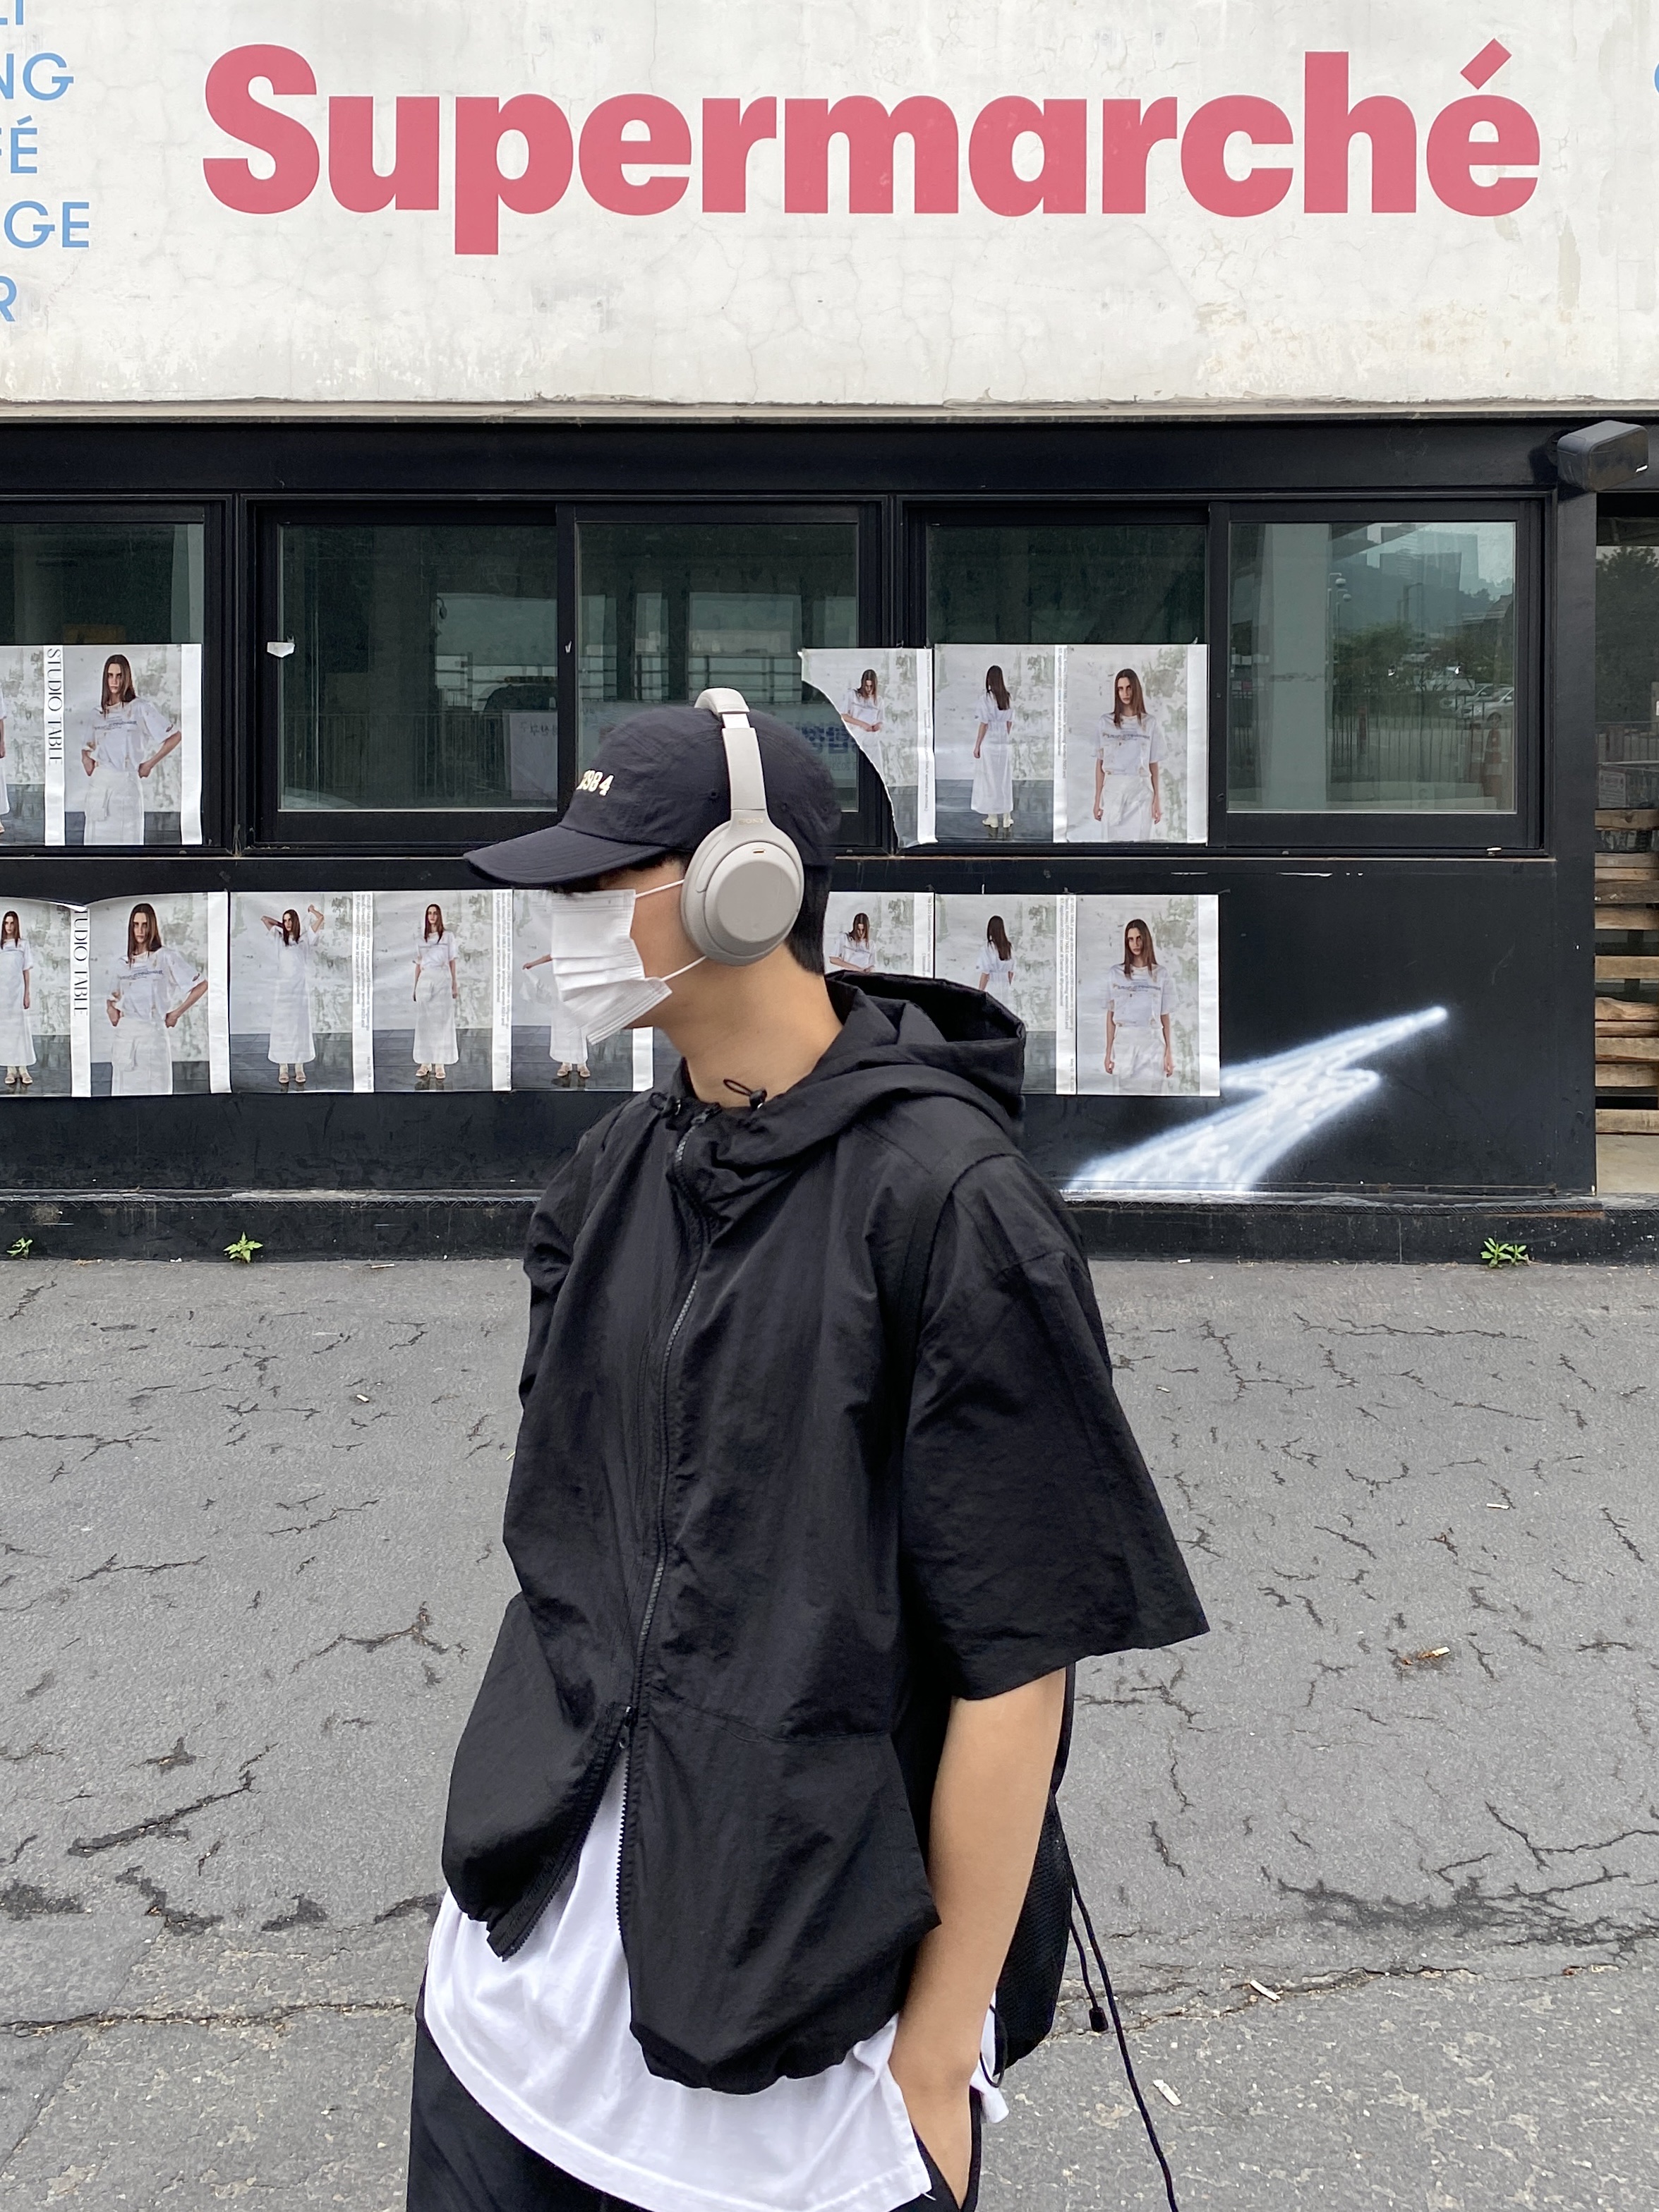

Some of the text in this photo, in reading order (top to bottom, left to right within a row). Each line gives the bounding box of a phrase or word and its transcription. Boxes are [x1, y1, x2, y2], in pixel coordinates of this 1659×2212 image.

[0, 0, 23, 25] I
[0, 116, 37, 174] É
[204, 39, 1540, 255] Supermarché
[4, 200, 89, 248] GE
[47, 648, 63, 766] STUDIO TABLE
[73, 908, 89, 1017] TUDIO TABLE
